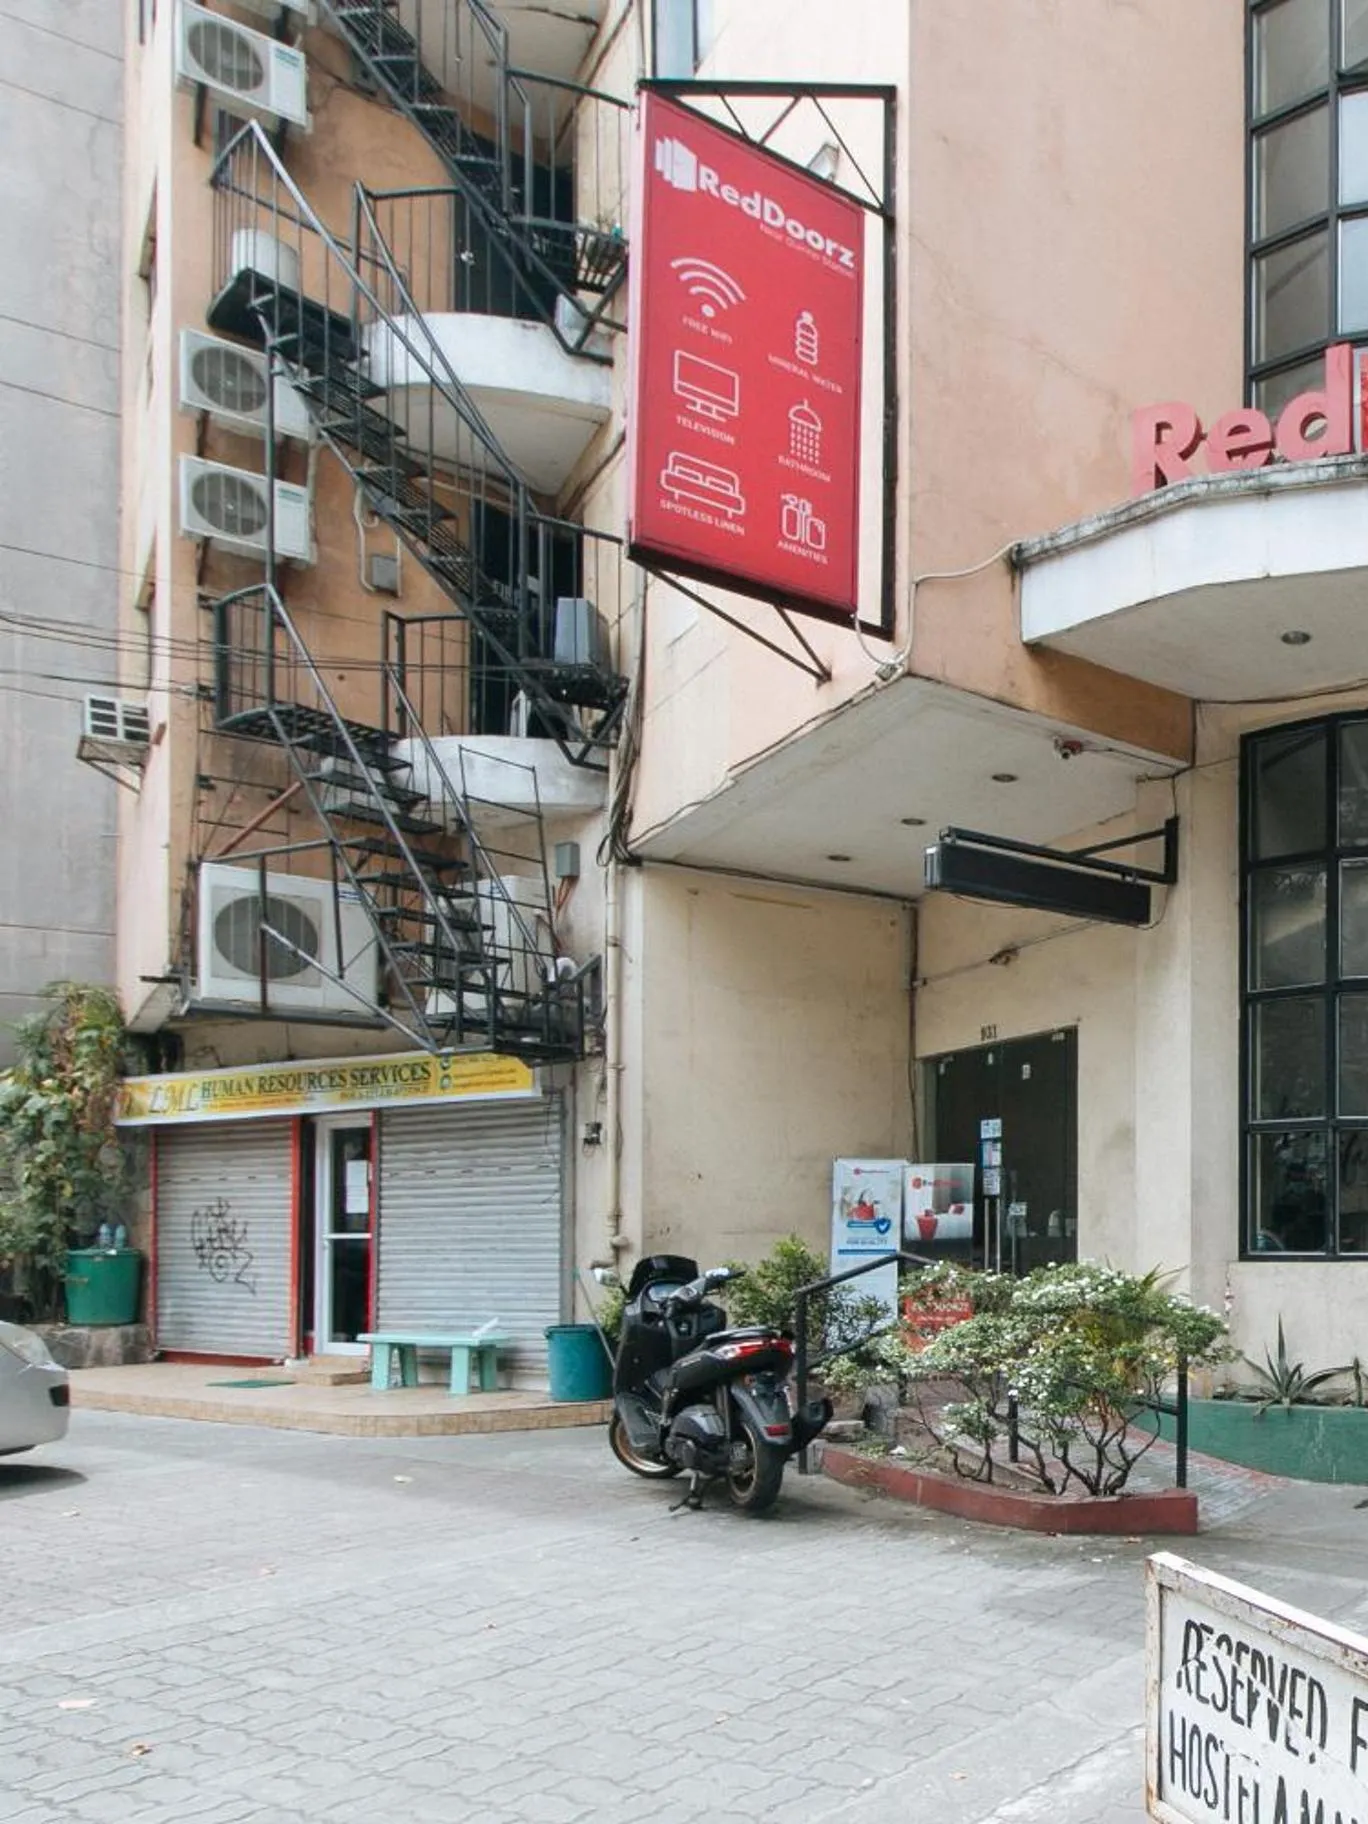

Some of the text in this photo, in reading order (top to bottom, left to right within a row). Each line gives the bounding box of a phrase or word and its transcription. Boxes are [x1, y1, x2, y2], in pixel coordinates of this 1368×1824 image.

[699, 163, 856, 270] RedDoorz
[676, 414, 736, 446] TELEVISION
[777, 454, 832, 483] BATHROOM
[660, 499, 745, 537] SPOTLESS LINEN
[777, 539, 829, 566] AMENITIES
[201, 1075, 257, 1099] HUMAN
[258, 1066, 348, 1093] RESOURCES
[350, 1061, 432, 1087] SERVICES
[1176, 1618, 1328, 1766] RESERVED
